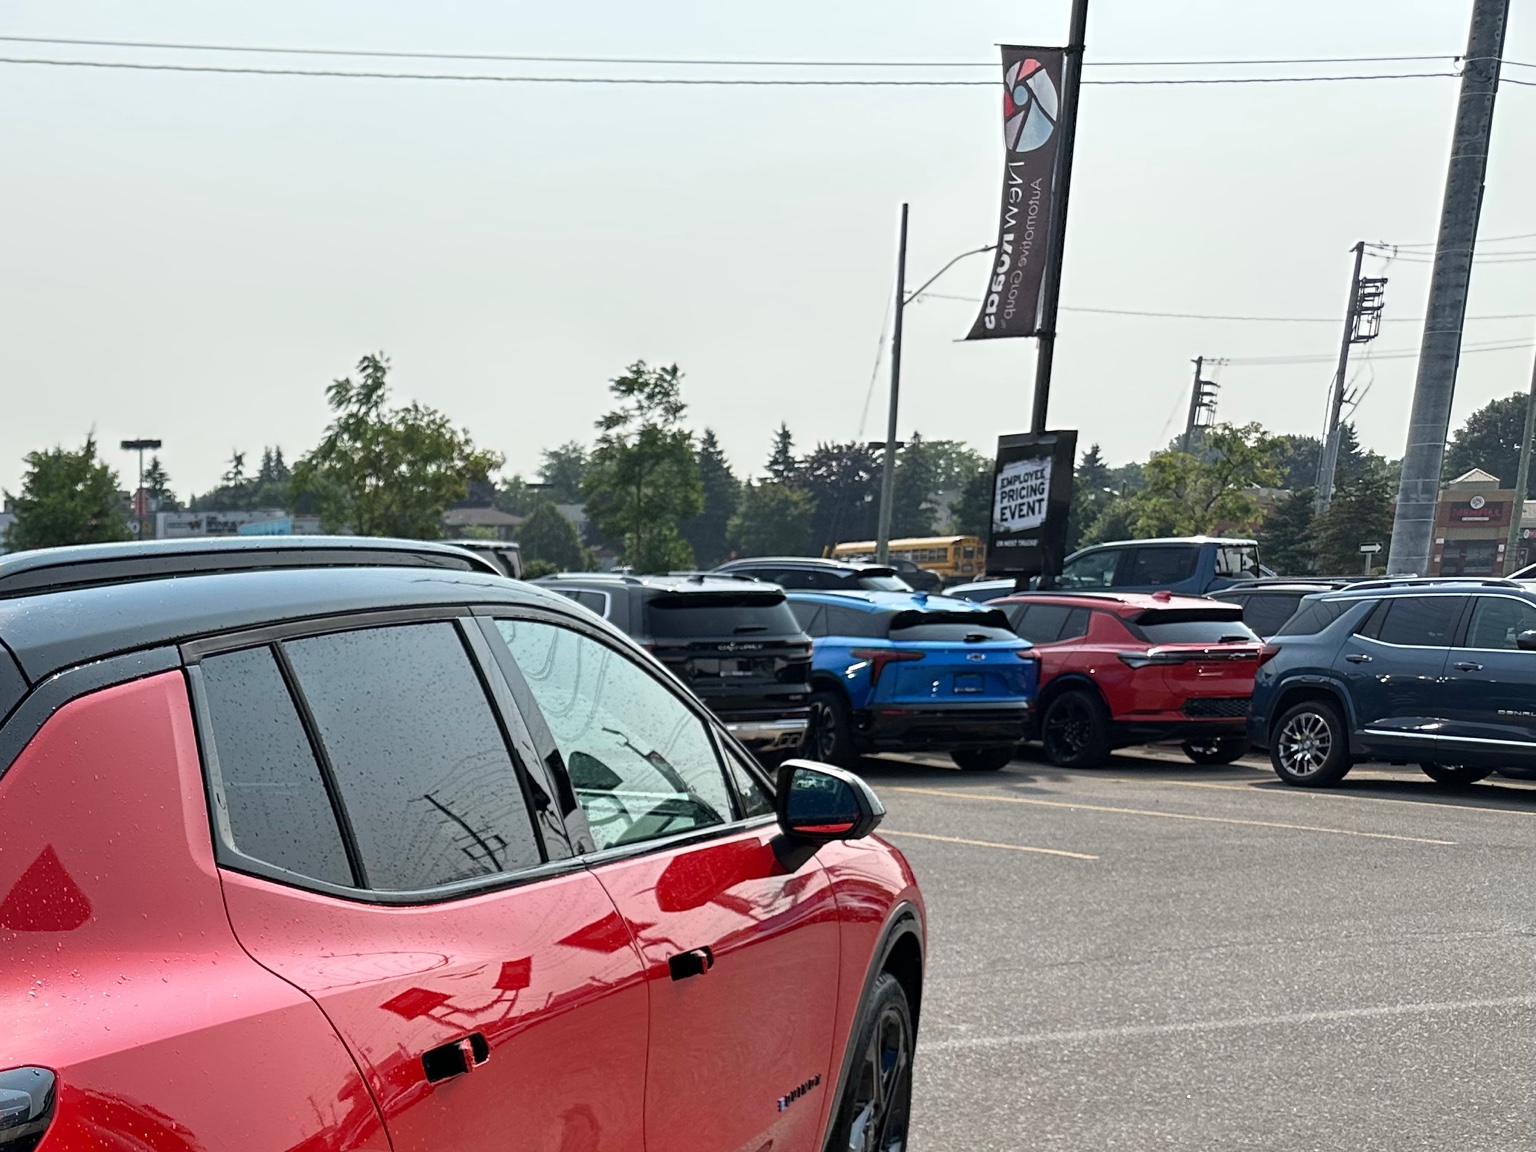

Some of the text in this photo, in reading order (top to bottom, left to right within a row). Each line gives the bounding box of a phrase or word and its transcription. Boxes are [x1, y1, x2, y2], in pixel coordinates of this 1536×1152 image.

[1000, 468, 1045, 490] EMPLOYEE
[1000, 482, 1045, 504] PRICING
[1000, 499, 1044, 522] EVENT
